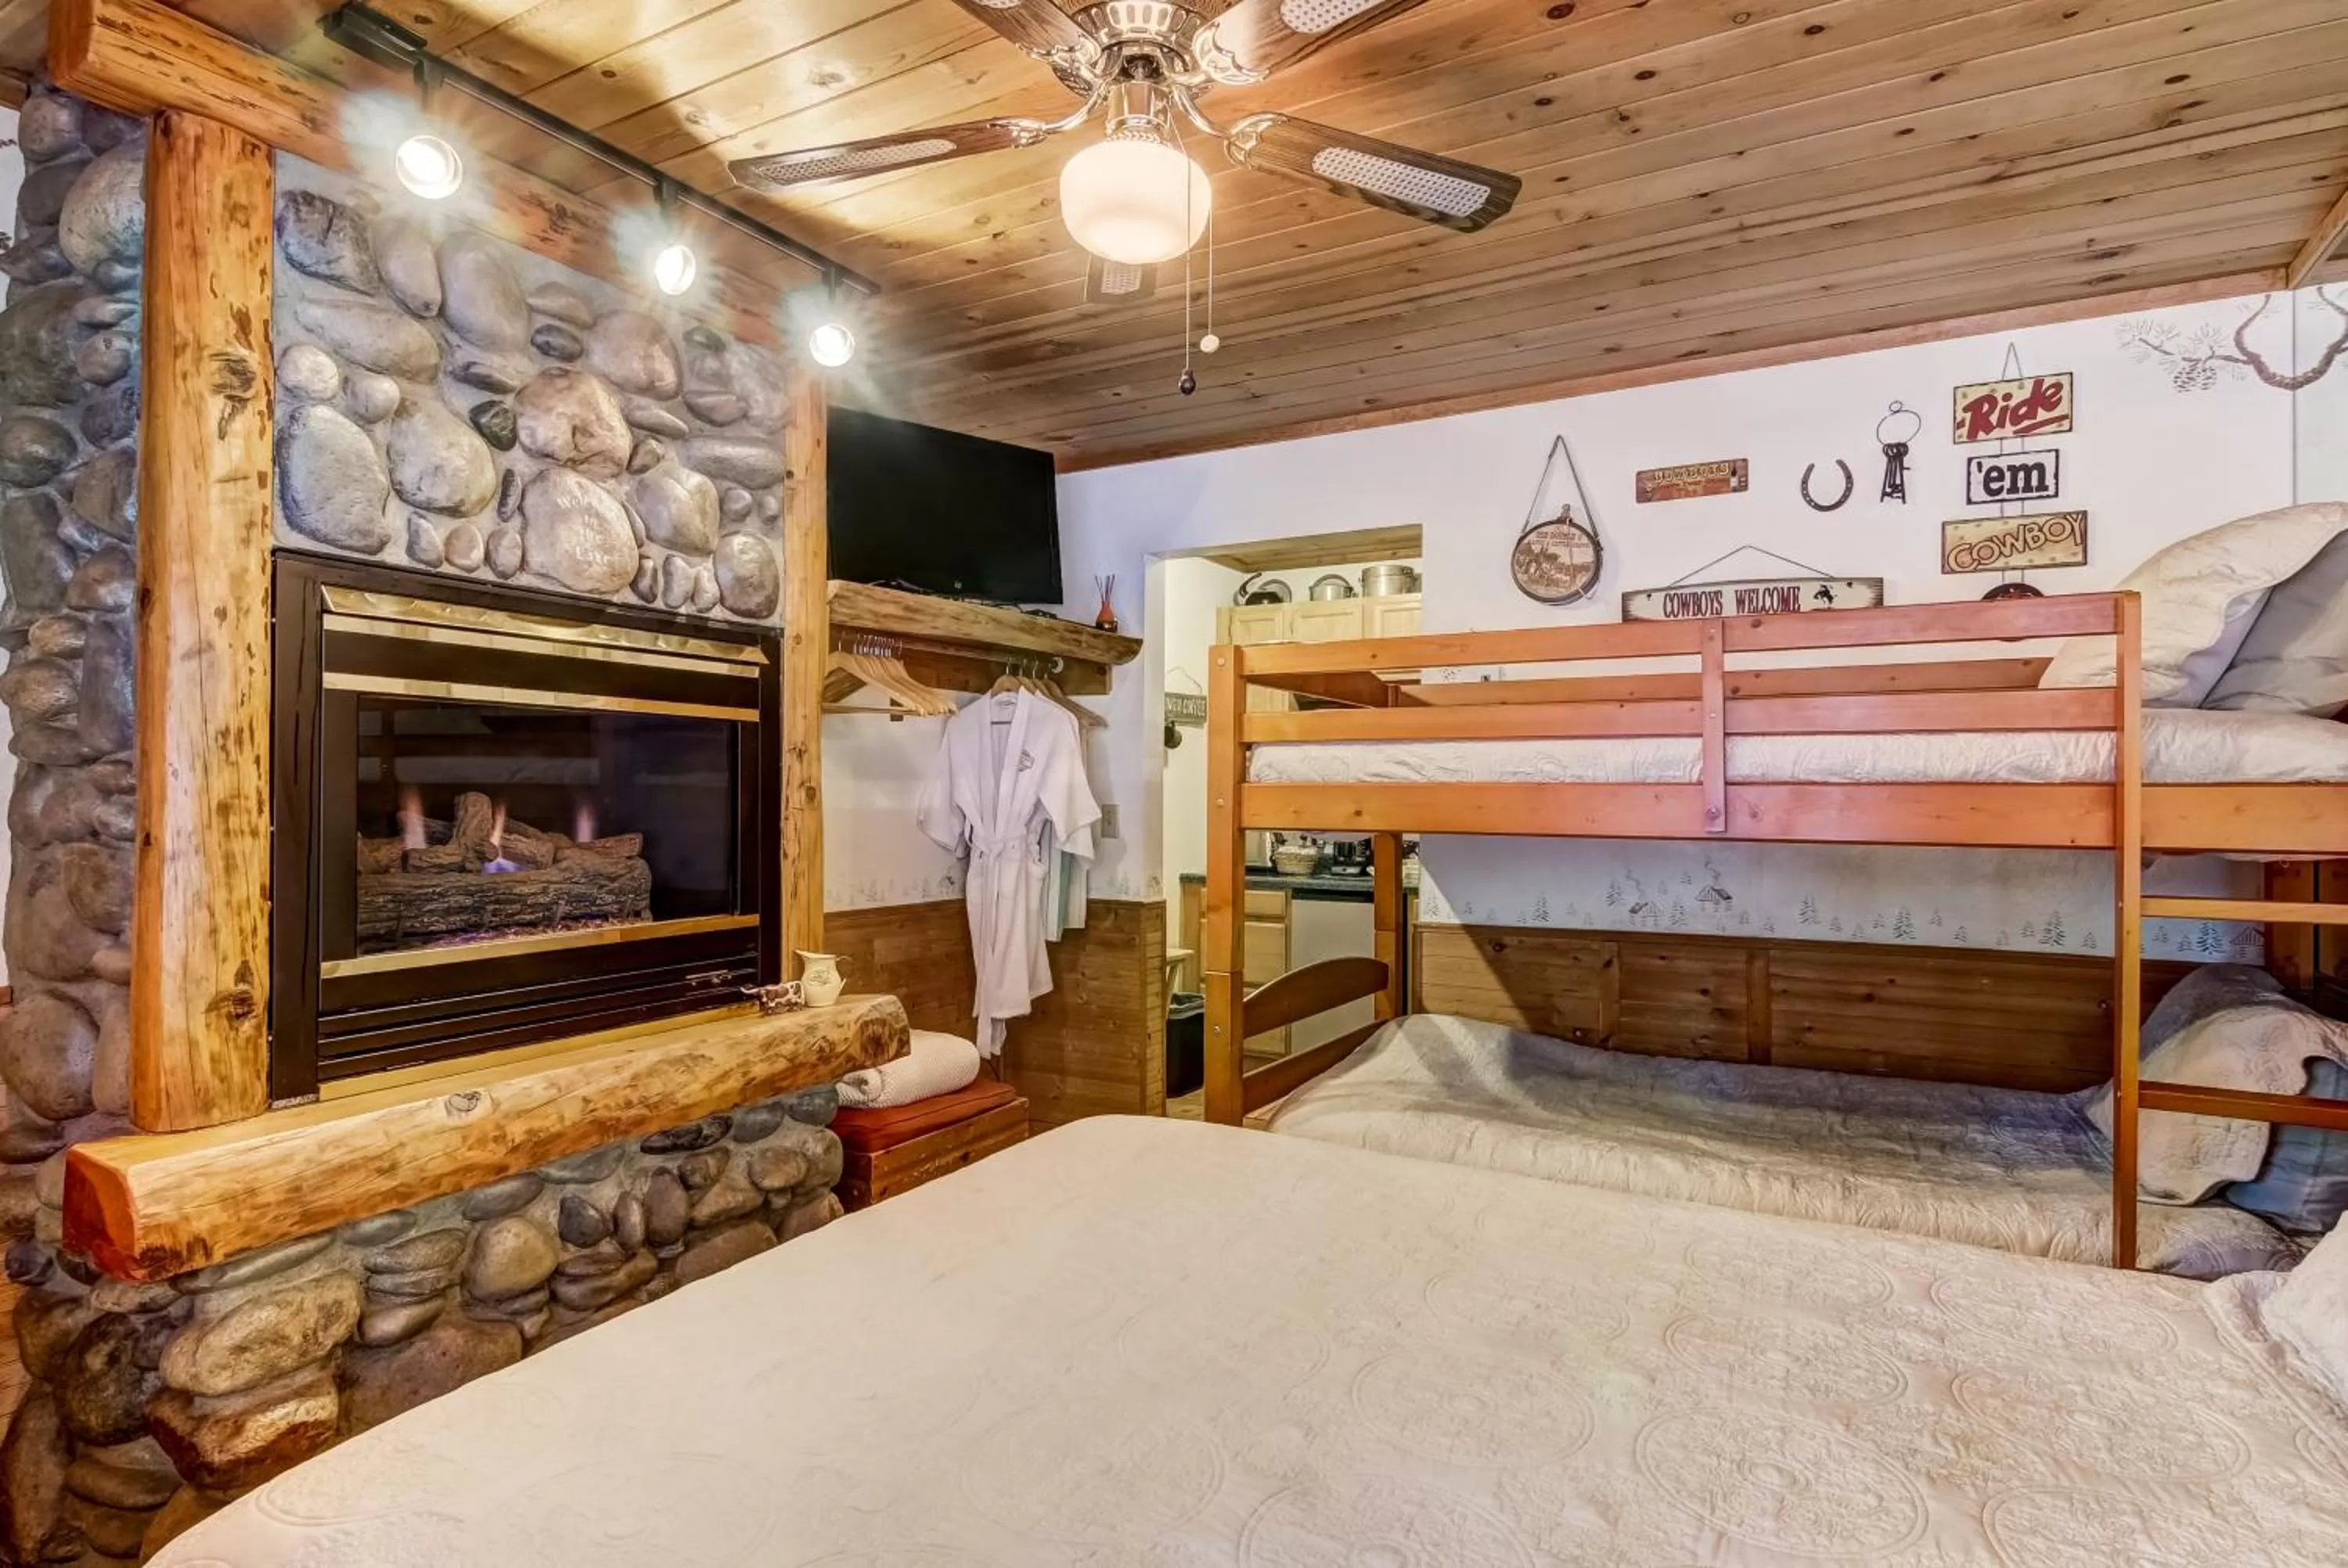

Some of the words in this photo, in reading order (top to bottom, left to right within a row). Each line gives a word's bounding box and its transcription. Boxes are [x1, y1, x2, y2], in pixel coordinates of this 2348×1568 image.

[1963, 376, 2064, 441] Ride
[1976, 460, 2049, 497] 'em
[1947, 511, 2085, 573] COWBOY
[1663, 589, 1723, 618] COWBOYS
[1734, 586, 1801, 614] WELCOME
